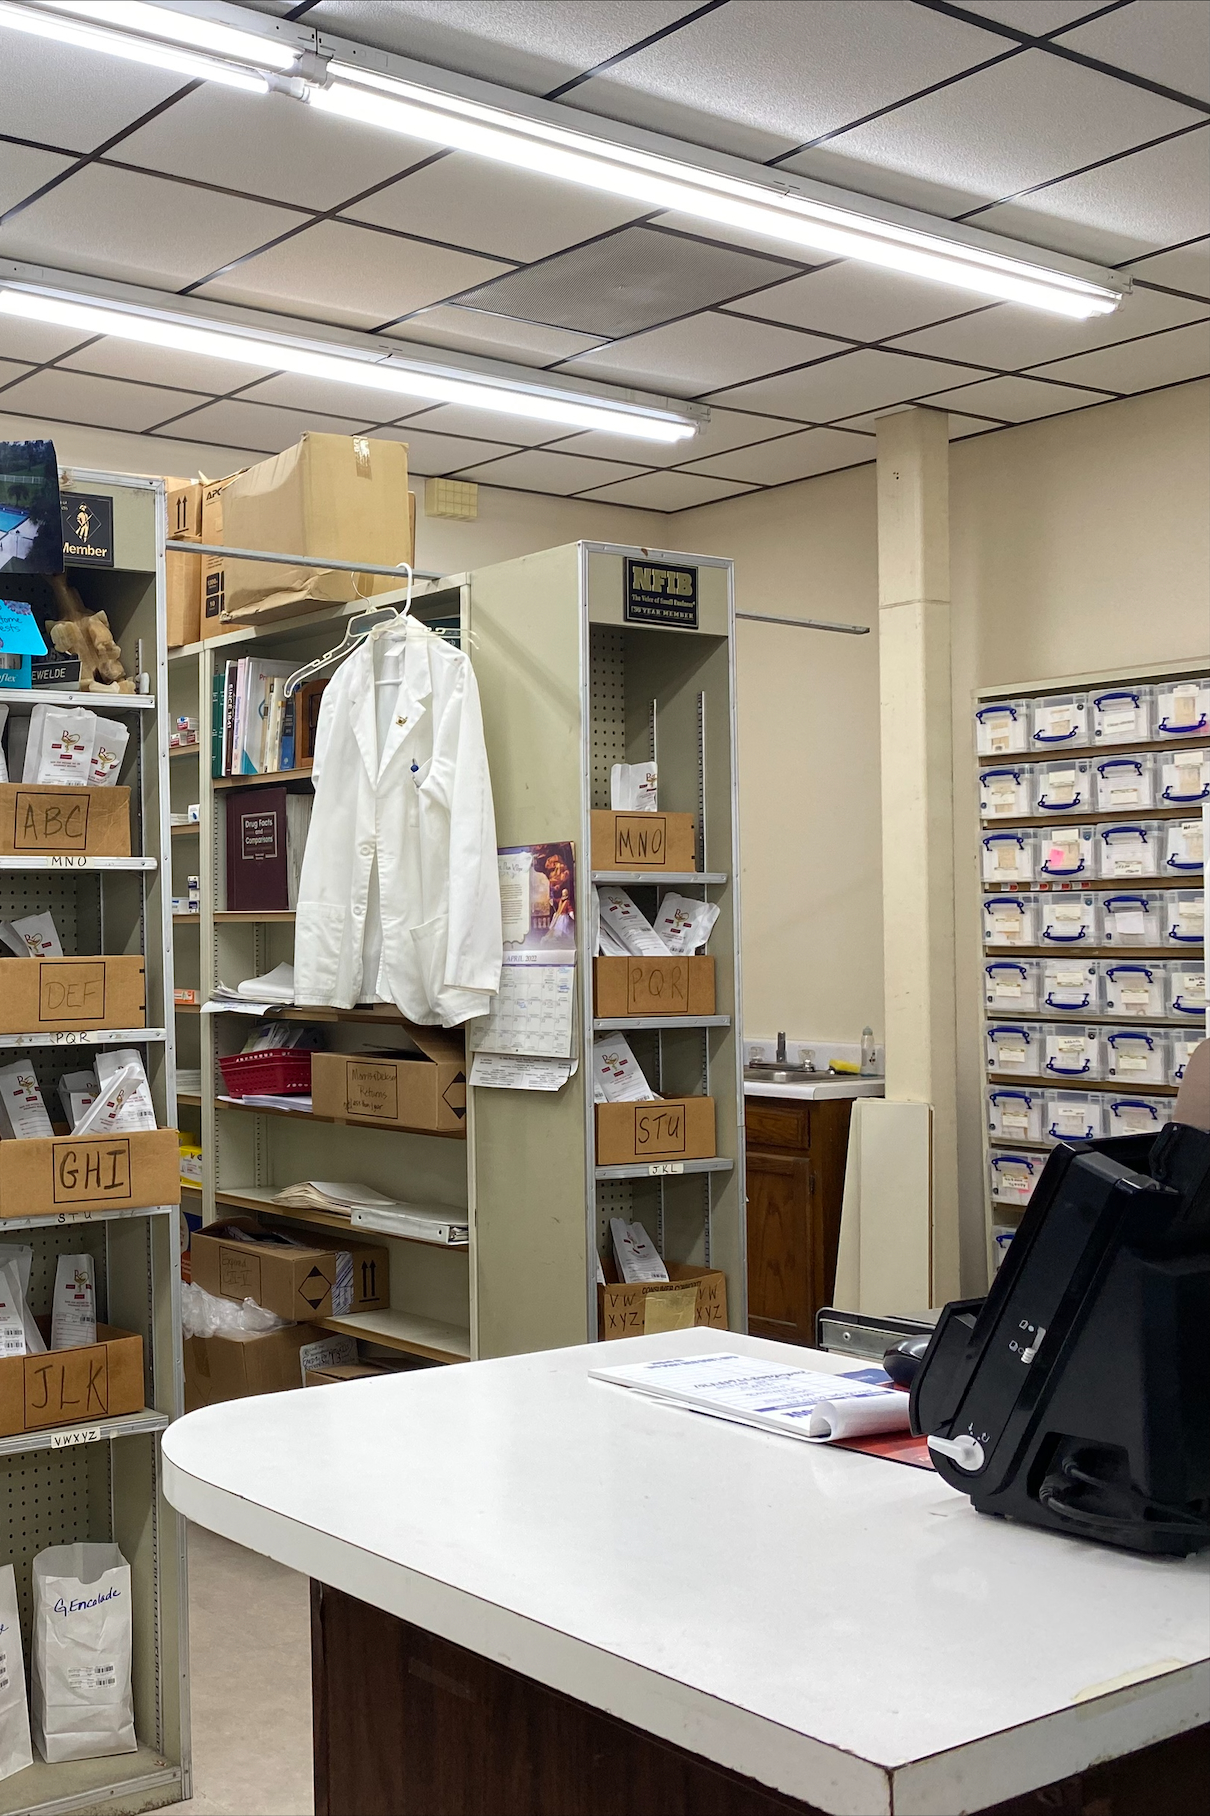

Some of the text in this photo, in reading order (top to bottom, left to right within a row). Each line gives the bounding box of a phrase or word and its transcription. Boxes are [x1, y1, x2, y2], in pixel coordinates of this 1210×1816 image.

[632, 566, 693, 596] NFIB
[663, 610, 694, 619] MEMBER
[24, 803, 83, 840] ABC
[245, 818, 273, 829] Drug Facts
[245, 835, 273, 845] Comparisons
[619, 828, 662, 858] MNO
[51, 856, 87, 867] MNO
[45, 979, 102, 1009] DEF
[630, 966, 683, 1002] PQR
[56, 1032, 90, 1044] PQR
[638, 1112, 680, 1144] STU
[59, 1149, 126, 1190] GHI
[652, 1166, 678, 1174] JKL
[57, 1212, 92, 1224] STU
[31, 1360, 108, 1414] JLK
[54, 1430, 97, 1446] VWXYZ
